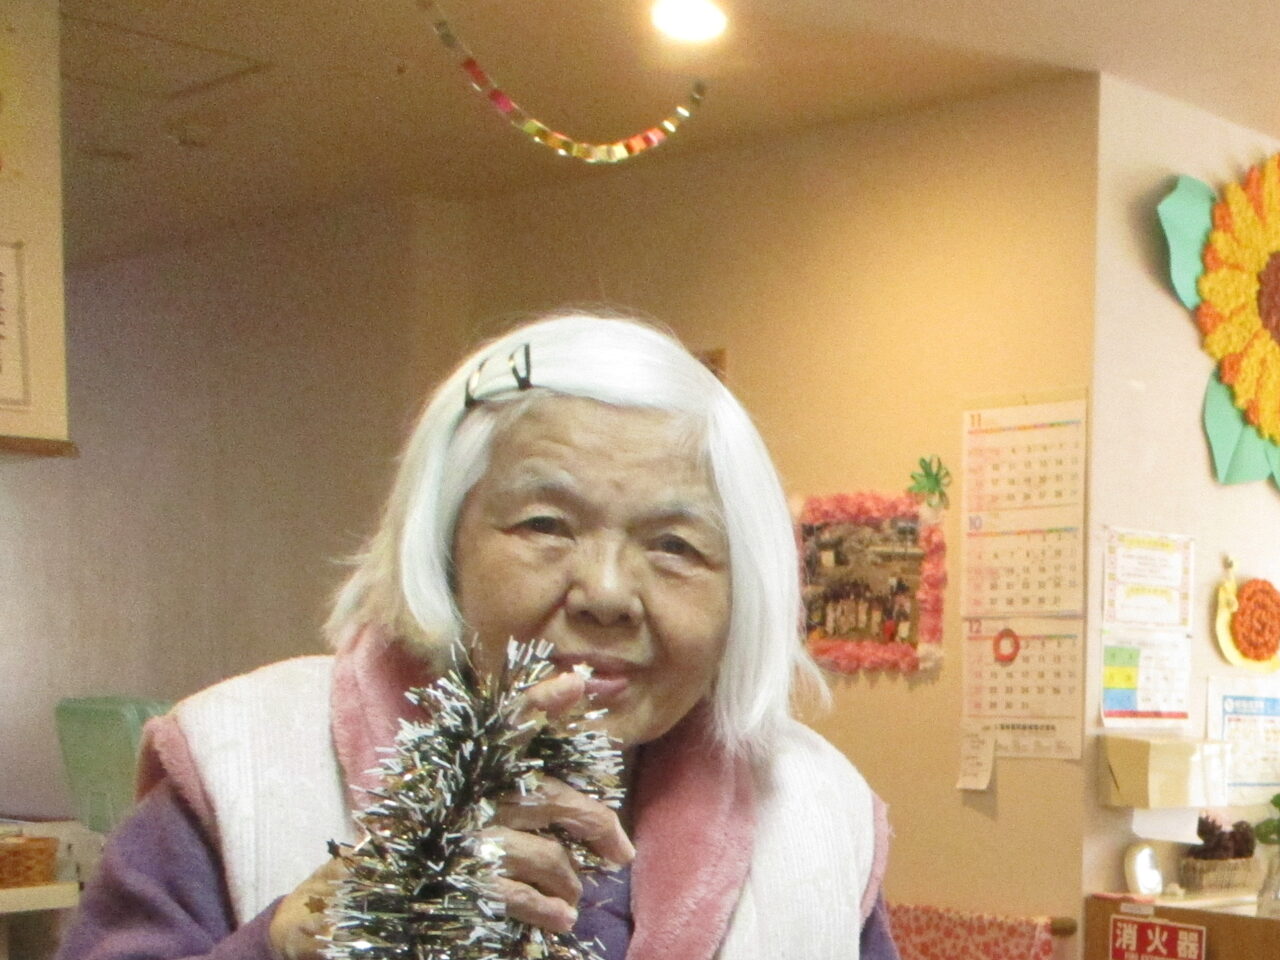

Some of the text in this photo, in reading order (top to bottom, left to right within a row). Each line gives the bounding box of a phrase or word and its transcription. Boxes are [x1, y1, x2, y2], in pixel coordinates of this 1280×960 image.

[970, 413, 982, 428] 11
[969, 516, 982, 530] 10
[969, 619, 982, 633] 12
[1115, 920, 1199, 960] 消火器
